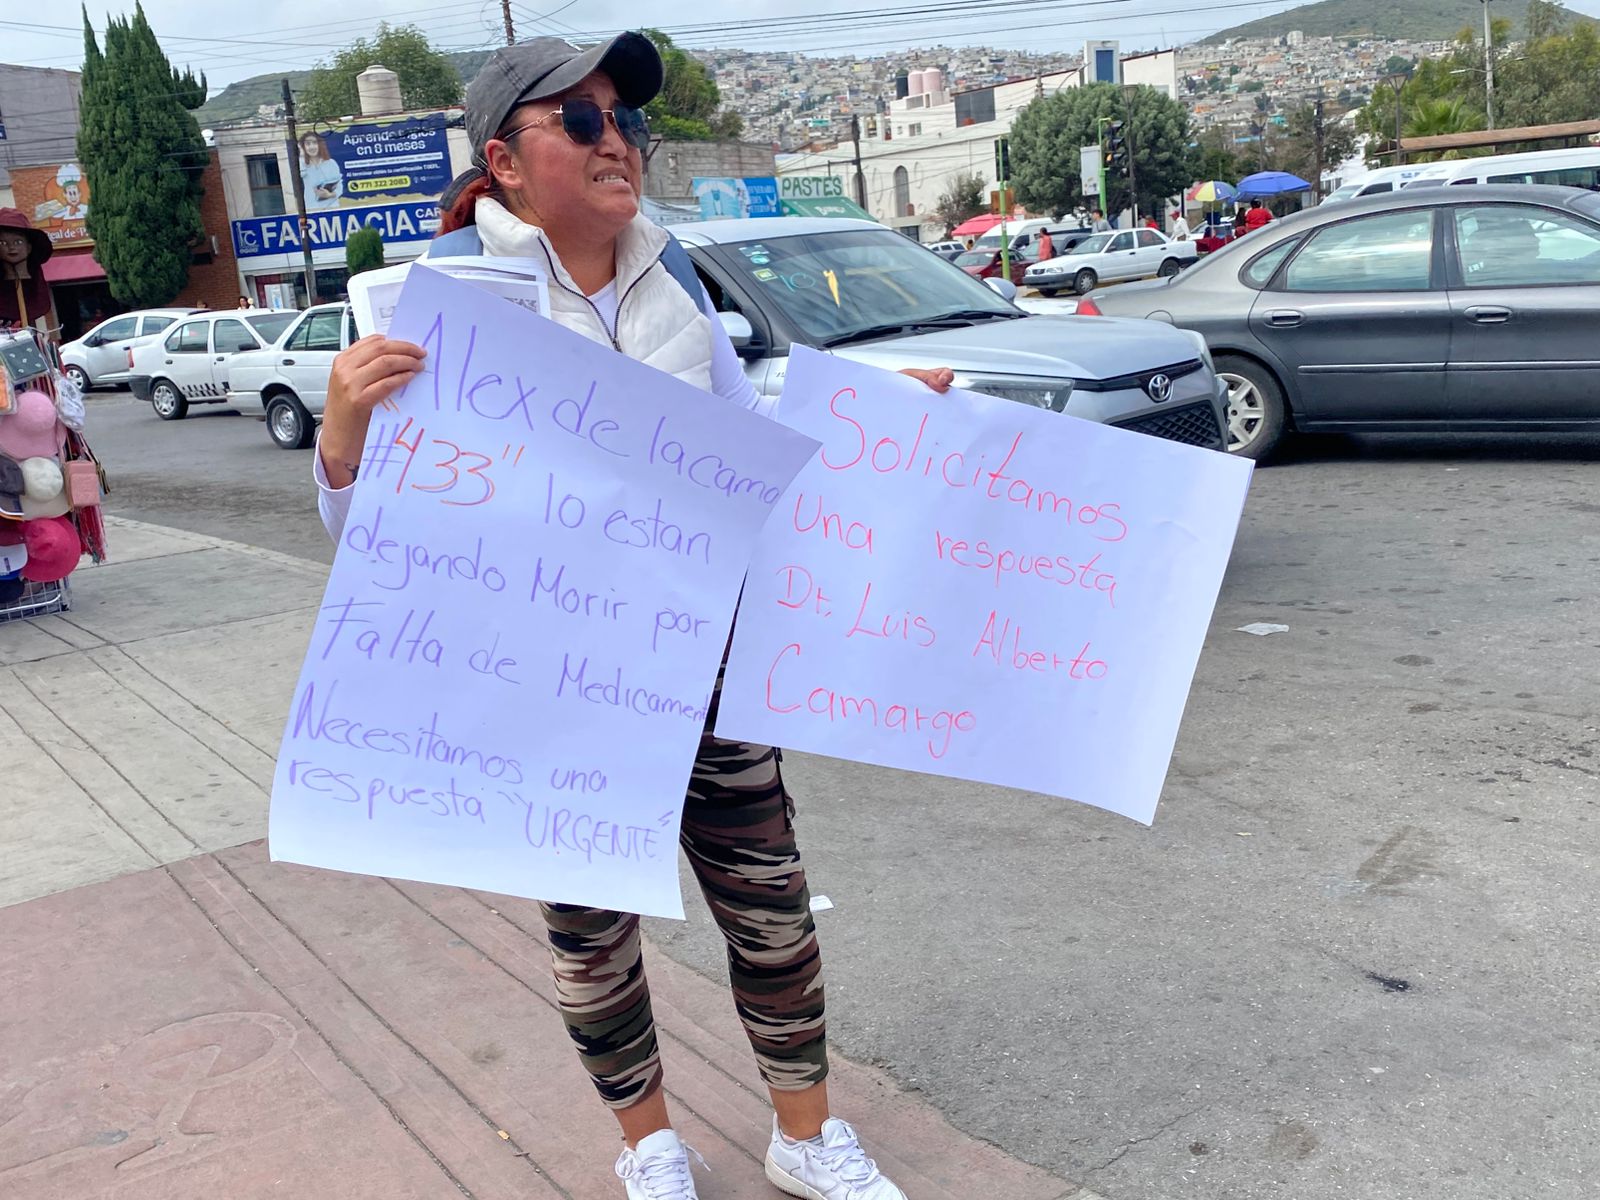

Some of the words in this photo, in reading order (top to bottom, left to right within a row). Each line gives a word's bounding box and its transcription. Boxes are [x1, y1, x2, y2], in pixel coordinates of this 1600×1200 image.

[356, 145, 372, 155] en
[374, 143, 382, 154] 8
[384, 140, 426, 153] meses
[782, 175, 843, 198] PASTES
[260, 208, 417, 249] FARMACIA
[399, 311, 537, 432] Alex
[552, 380, 630, 458] de
[820, 386, 1128, 543] Solicitamos
[545, 472, 586, 529] lo
[603, 498, 712, 564] estan
[793, 493, 874, 555] Una
[935, 530, 1119, 608] respuesta
[346, 506, 507, 592] dejando
[530, 557, 629, 620] Morir
[653, 606, 713, 653] por
[322, 596, 445, 667] Falta
[468, 631, 521, 685] de
[846, 582, 937, 648] Luis
[971, 609, 1109, 681] Alberto
[292, 678, 525, 785] Necesitamos
[550, 767, 608, 794] una
[765, 643, 978, 760] Camargo
[288, 758, 487, 824] respuesta
